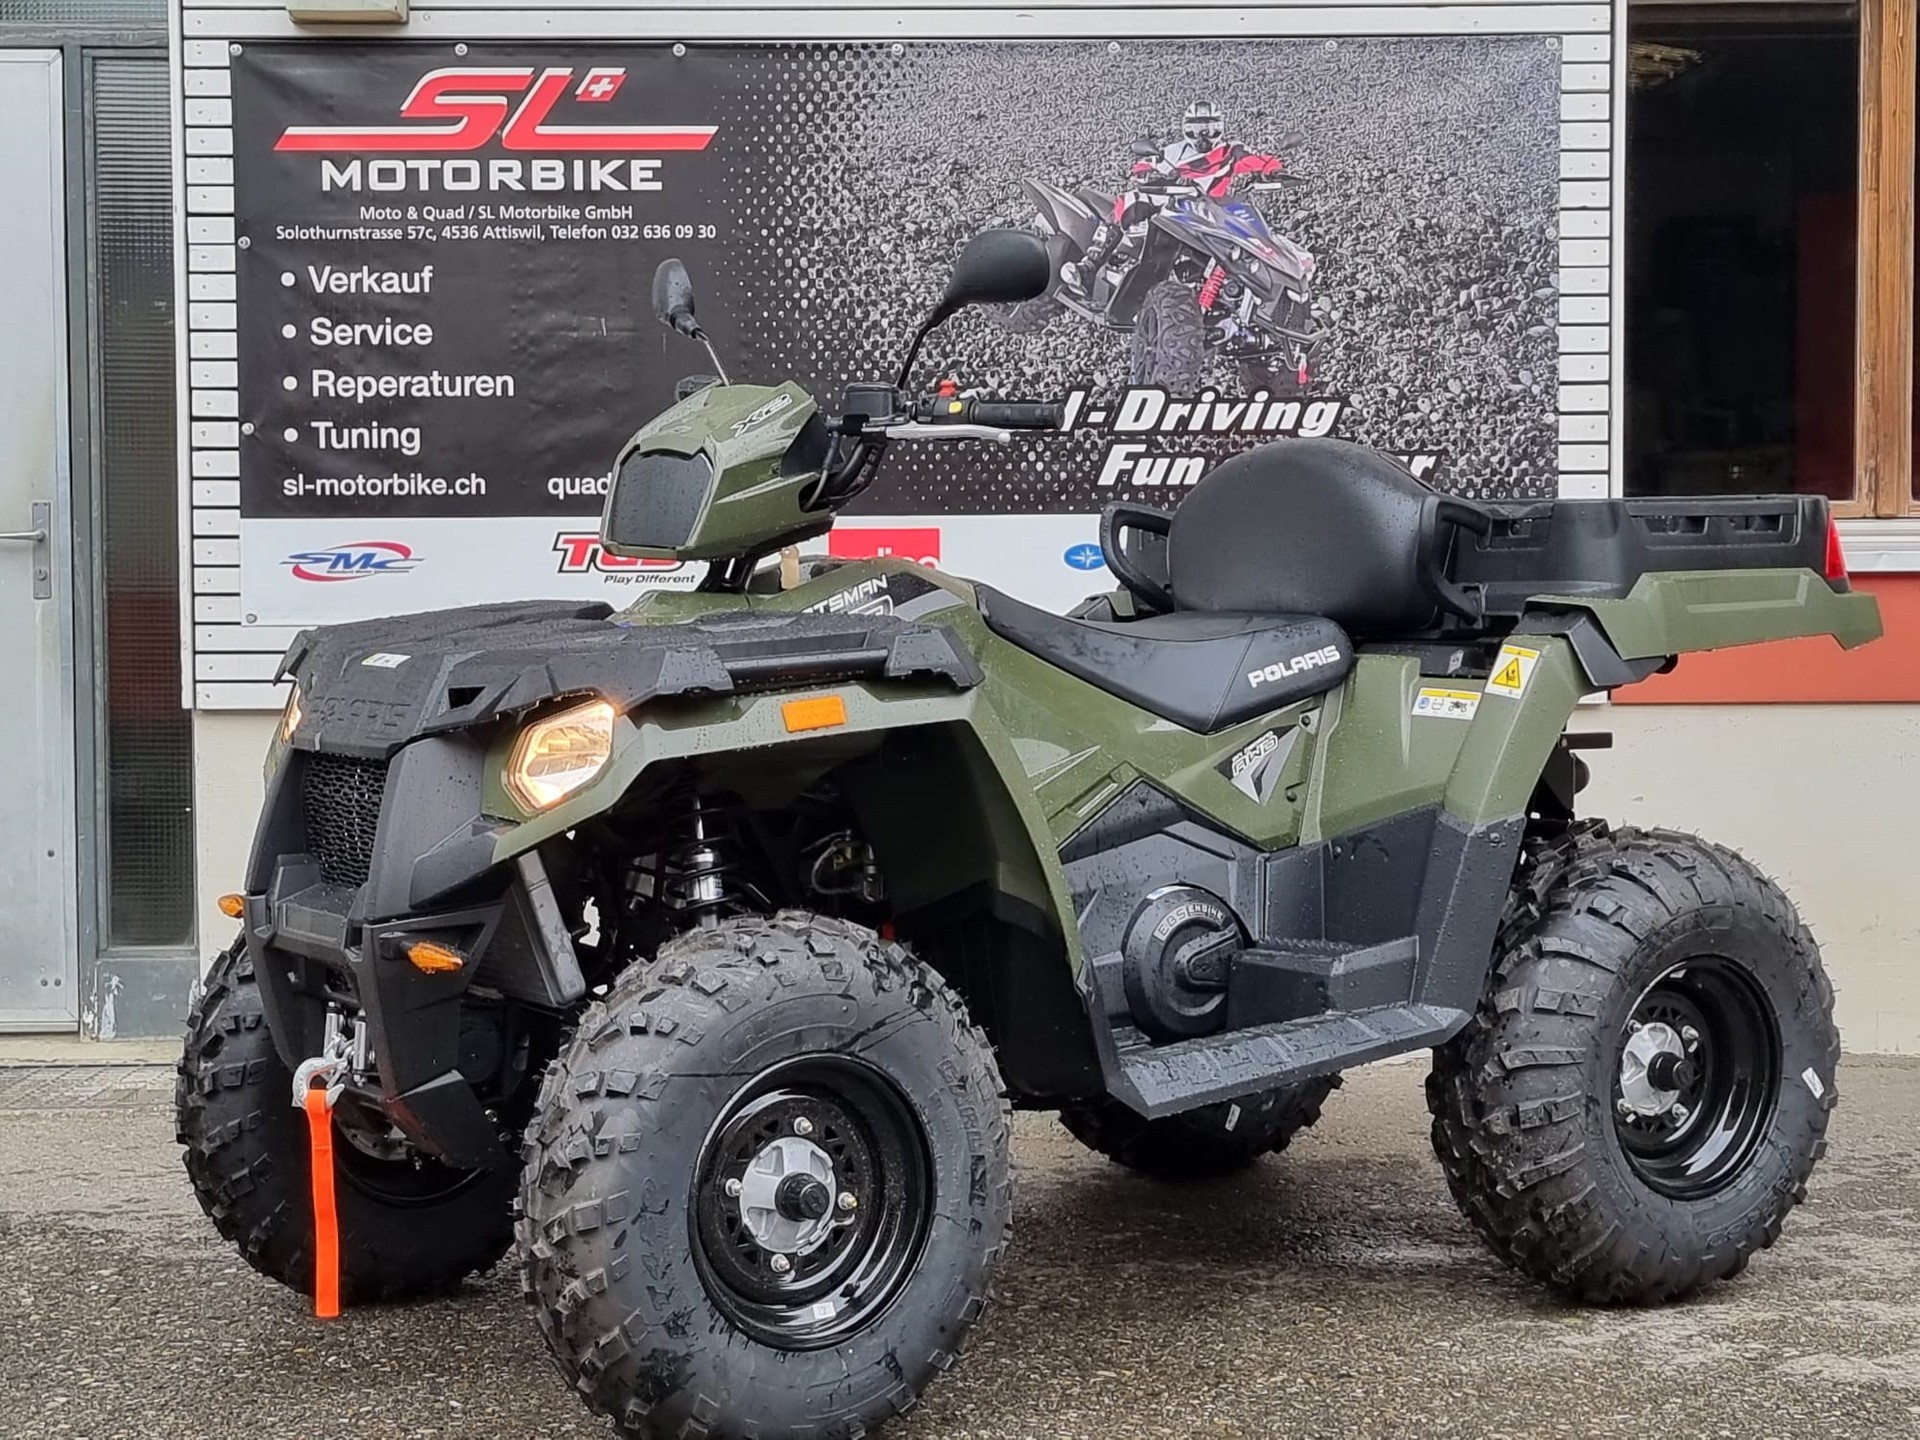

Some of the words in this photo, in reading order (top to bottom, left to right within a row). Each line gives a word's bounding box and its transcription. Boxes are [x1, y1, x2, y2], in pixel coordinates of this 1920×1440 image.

[321, 159, 663, 192] MOTORBIKE
[360, 205, 403, 220] Moto
[406, 205, 419, 220] &
[422, 204, 465, 222] Quad
[477, 205, 496, 220] SL
[499, 204, 581, 220] Motorbike
[584, 204, 633, 220] GmbH
[276, 224, 403, 240] Solothurnstrasse
[407, 225, 437, 242] 57c,
[441, 224, 479, 240] 4536
[482, 223, 546, 242] Attiswil,
[549, 224, 607, 240] Telefon
[611, 224, 640, 240] 032
[643, 224, 671, 239] 636
[674, 224, 694, 239] 09
[697, 224, 717, 239] 30
[307, 265, 434, 294] Verkauf
[310, 316, 434, 346] Service
[311, 369, 515, 404] Reperaturen
[310, 420, 421, 456] Tuning
[1097, 444, 1205, 486] Fun
[283, 472, 486, 496] sl-motorbike.ch
[603, 575, 634, 585] Play
[635, 574, 696, 584] Different
[1247, 645, 1341, 688] POLARIS
